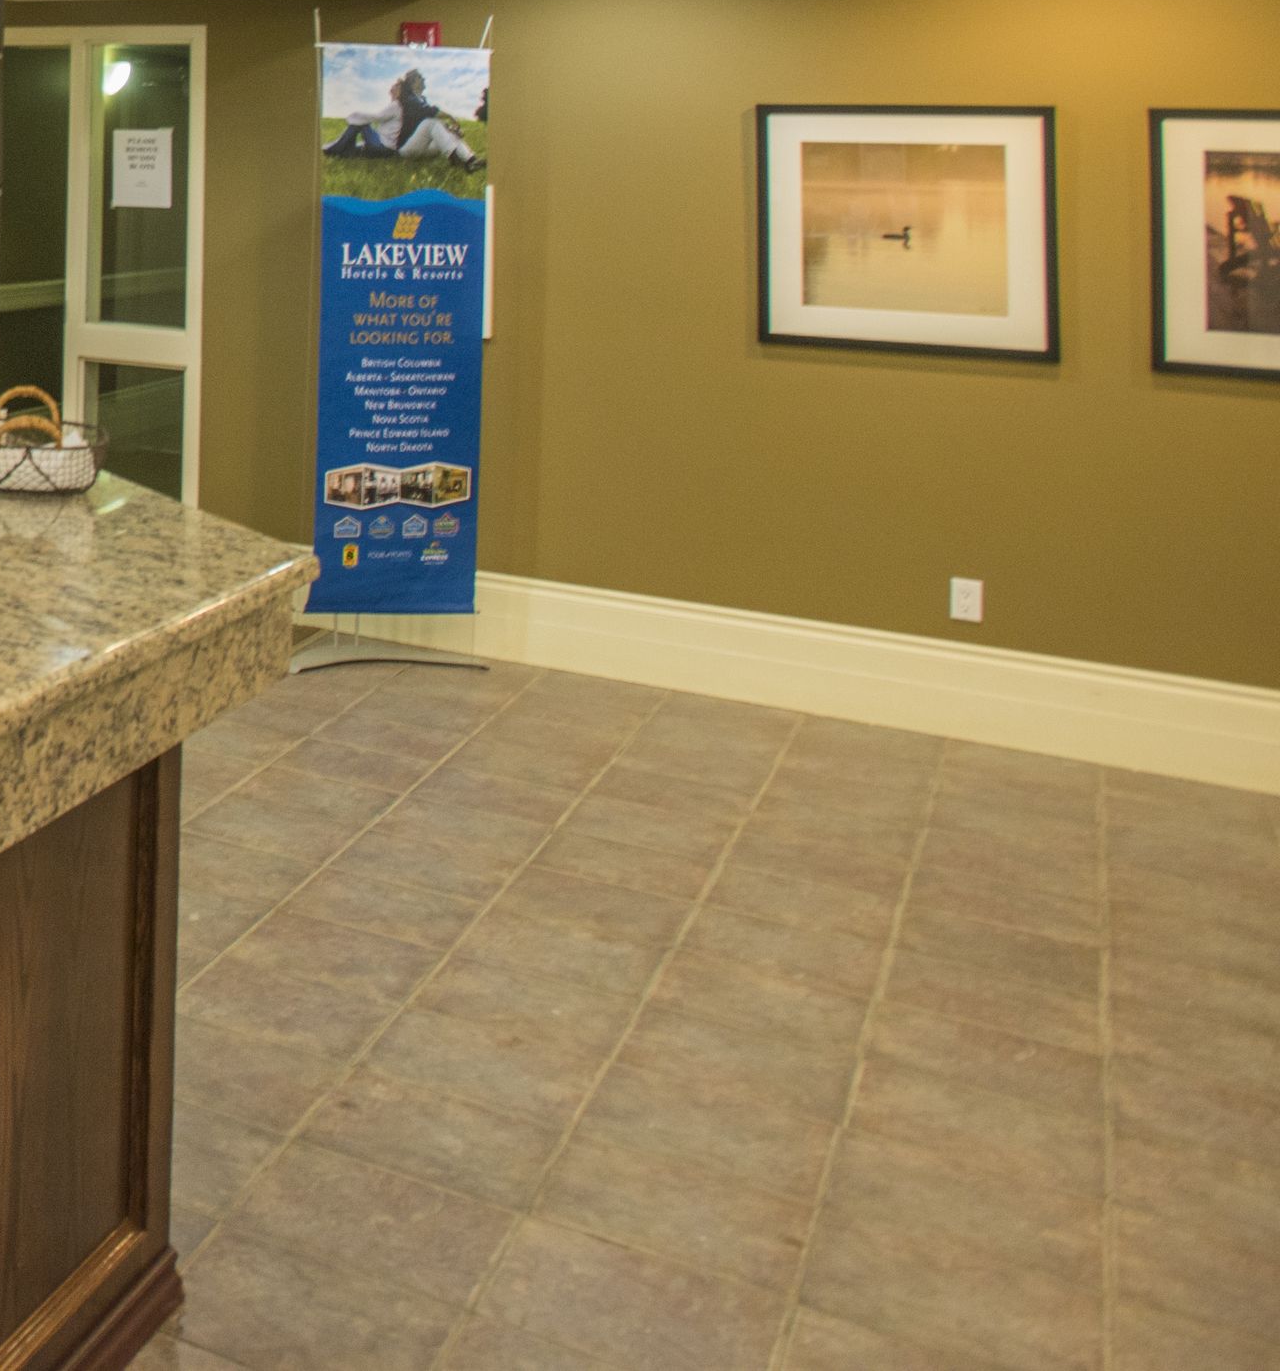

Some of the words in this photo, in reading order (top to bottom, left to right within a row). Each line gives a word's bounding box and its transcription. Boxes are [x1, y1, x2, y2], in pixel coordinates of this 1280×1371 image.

[341, 242, 468, 267] LAKEVIEW
[341, 266, 388, 280] Hotels
[394, 268, 406, 280] &
[412, 267, 464, 280] Resorts
[370, 291, 414, 308] MORE
[418, 294, 439, 308] OF
[353, 313, 396, 327] WHAT
[401, 309, 453, 327] YOU'RE
[350, 331, 419, 345] LOOKING
